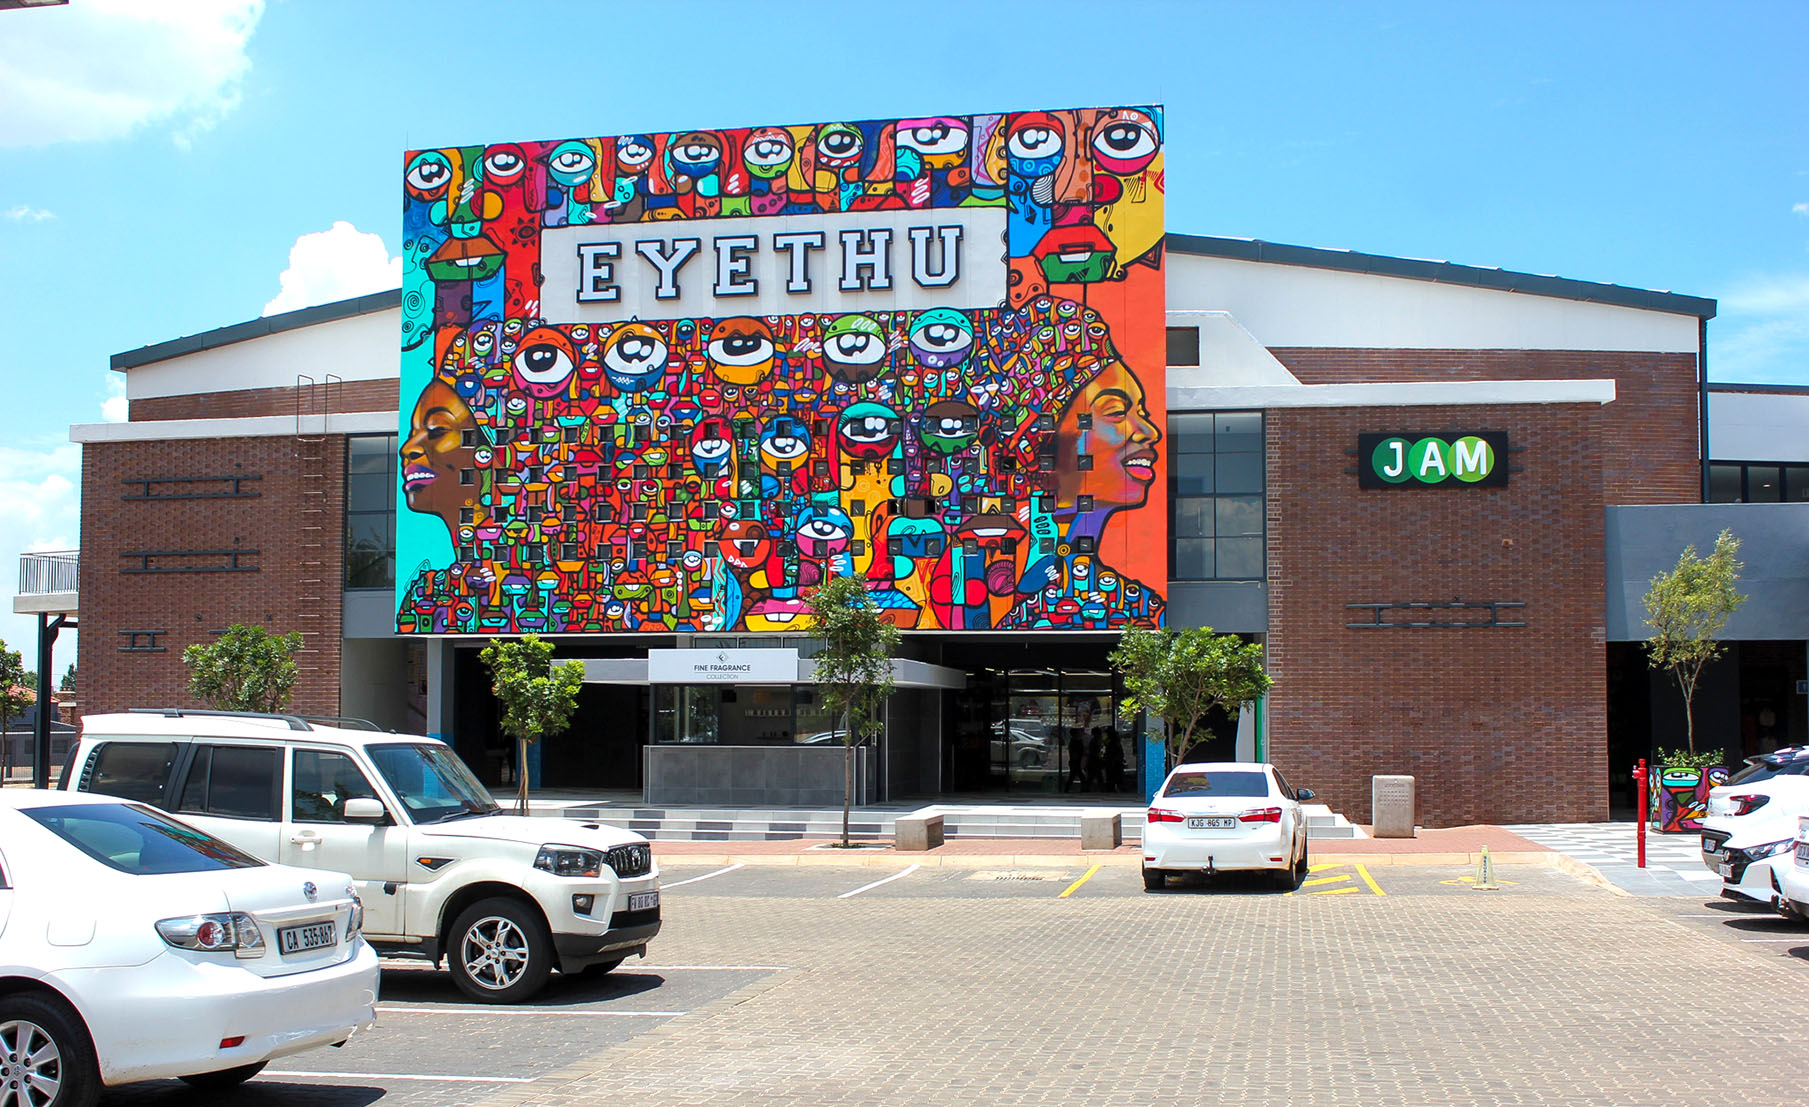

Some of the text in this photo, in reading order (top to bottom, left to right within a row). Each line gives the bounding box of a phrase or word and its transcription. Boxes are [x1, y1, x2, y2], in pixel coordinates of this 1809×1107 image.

[576, 224, 963, 304] EYETHU
[1383, 440, 1487, 477] JAM
[286, 930, 299, 950] CA
